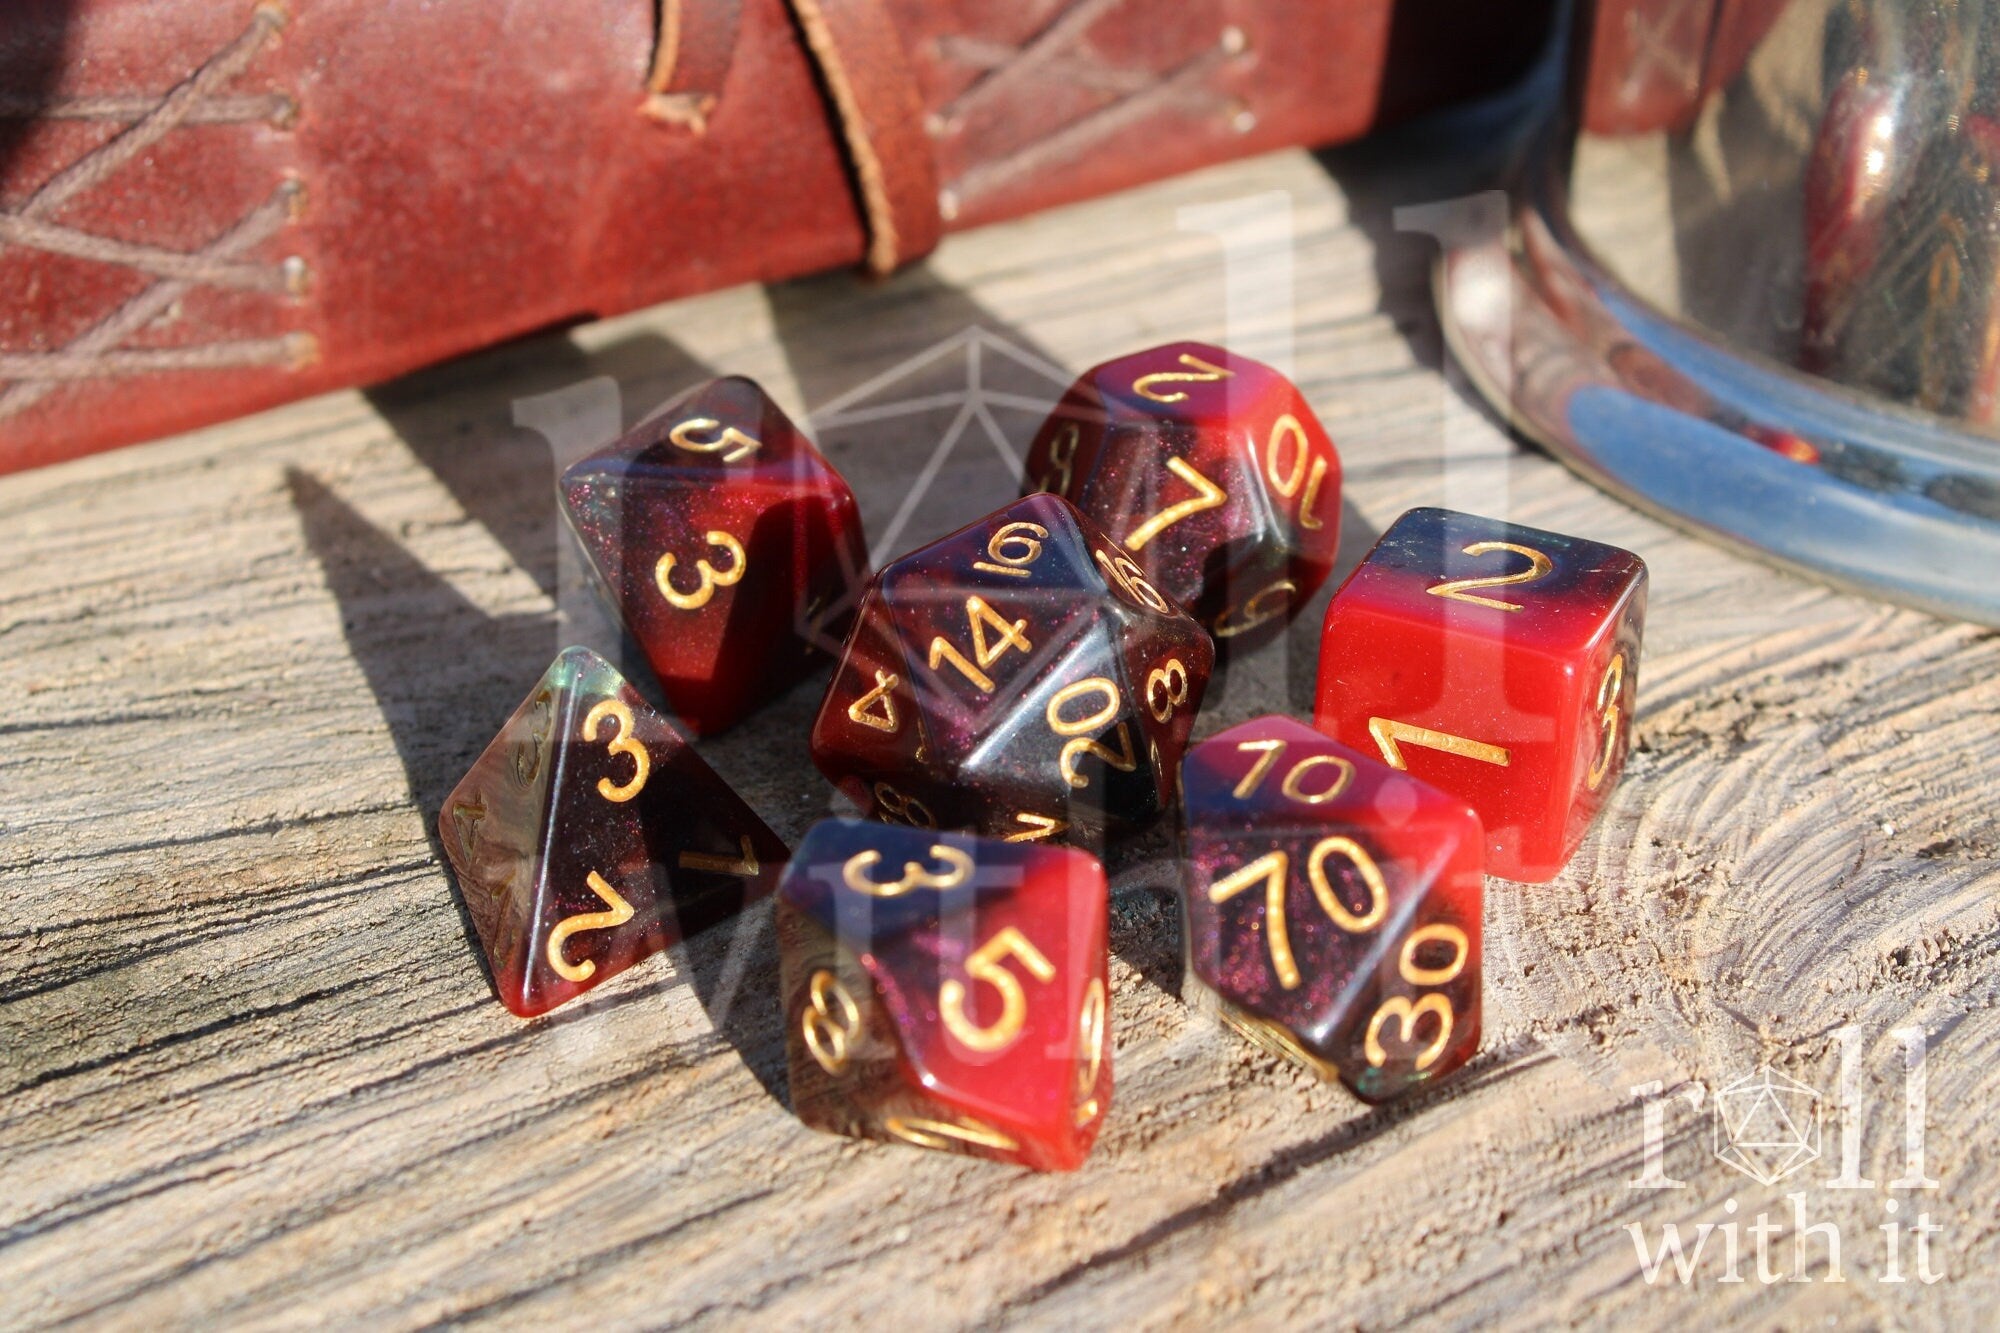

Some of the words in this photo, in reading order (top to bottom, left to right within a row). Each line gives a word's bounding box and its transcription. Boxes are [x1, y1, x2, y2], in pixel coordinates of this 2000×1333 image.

[1131, 352, 1235, 403] 2
[668, 417, 763, 464] 5
[1266, 413, 1329, 530] 10
[1123, 455, 1228, 551] 7
[655, 530, 747, 610] 3
[1425, 540, 1553, 612] 2
[928, 595, 1033, 694] 14
[1146, 657, 1189, 725] 8
[847, 668, 900, 733] 4
[1046, 676, 1138, 789] 20
[1368, 716, 1514, 771] 1
[1586, 652, 1624, 791] 3
[582, 699, 651, 803] 3
[1232, 738, 1357, 805] 10
[678, 833, 760, 876] 1
[842, 844, 977, 898] 3
[546, 870, 636, 983] 2
[1207, 836, 1390, 992] 70
[801, 967, 862, 1078] 8
[938, 925, 1058, 1051] 5
[1364, 922, 1471, 1072] 30
